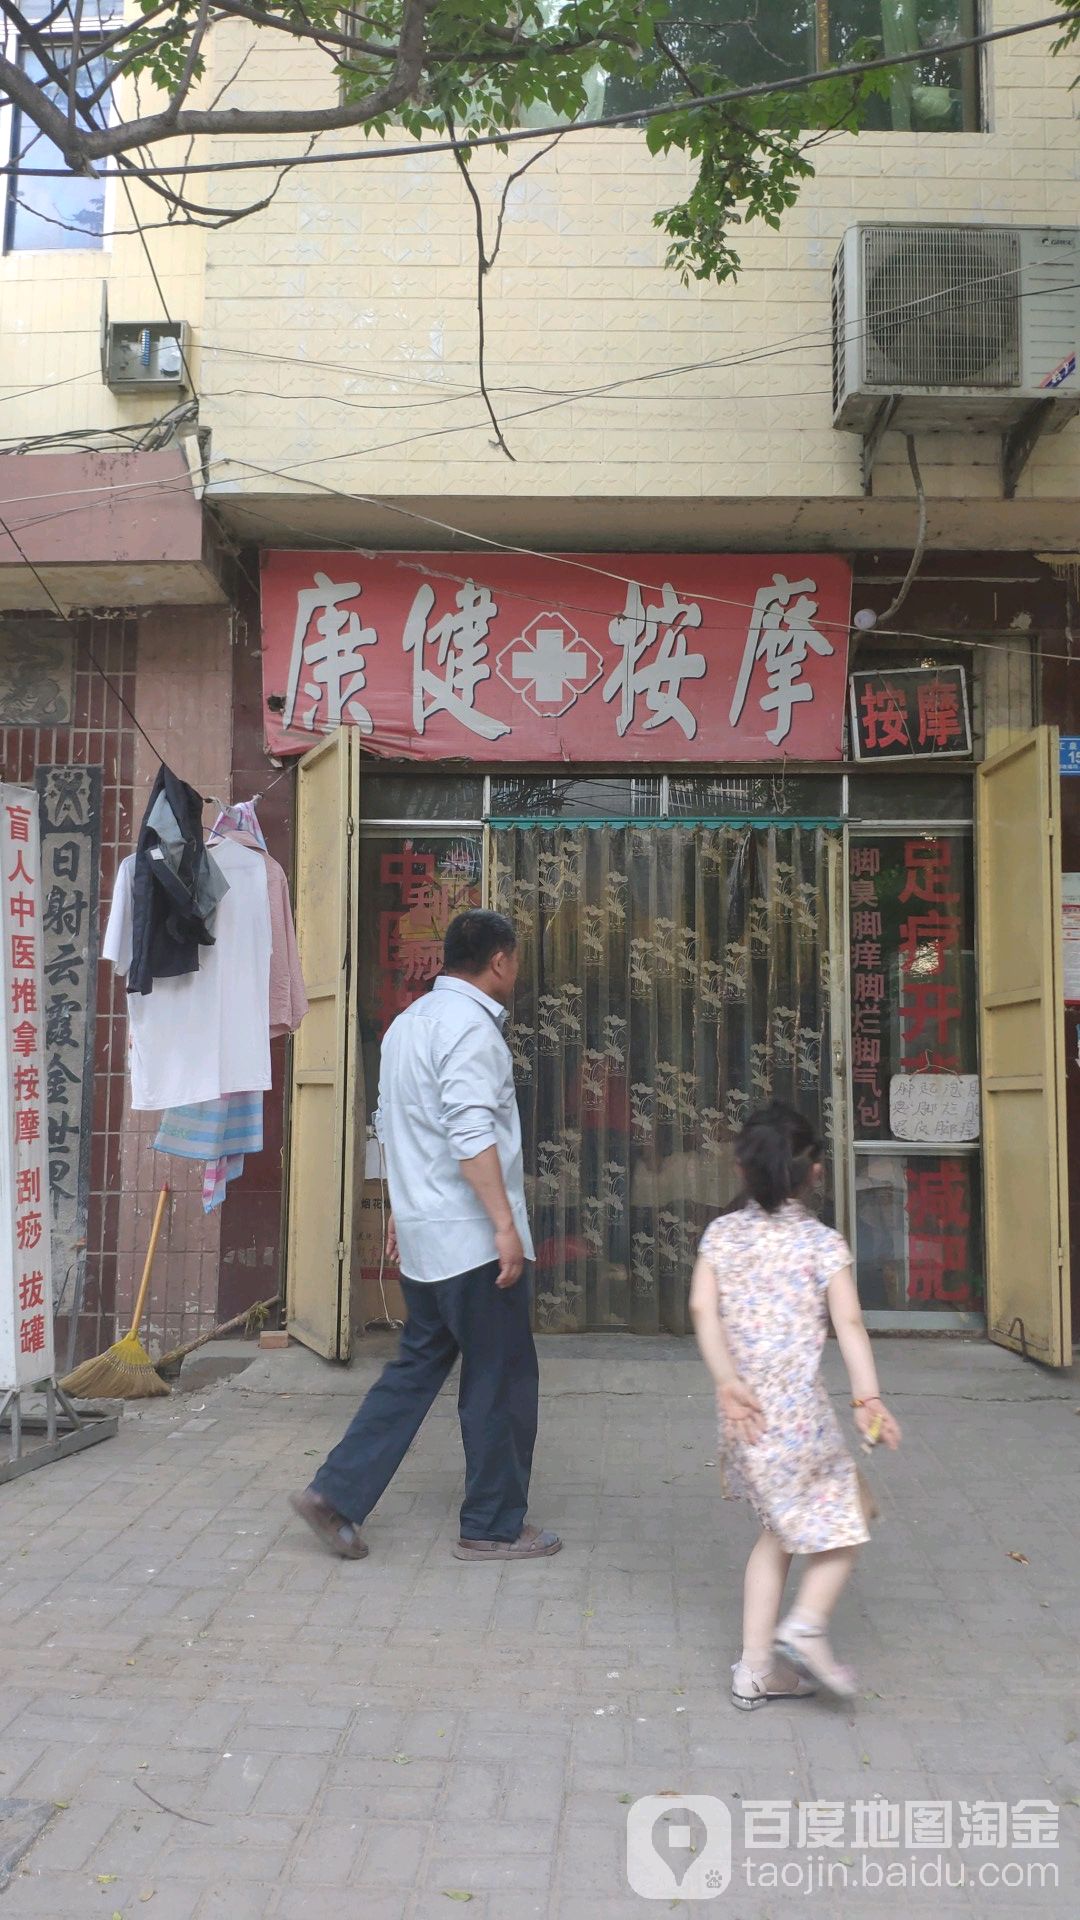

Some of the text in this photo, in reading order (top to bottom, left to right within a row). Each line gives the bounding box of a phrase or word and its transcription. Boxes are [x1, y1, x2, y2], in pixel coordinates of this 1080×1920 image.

[283, 572, 834, 745] 康健 按摩
[860, 678, 962, 749] 按摩
[6, 805, 46, 1354] 盲人中医推拿按摩 刮痧 拔罐
[905, 1158, 971, 1301] 减肥
